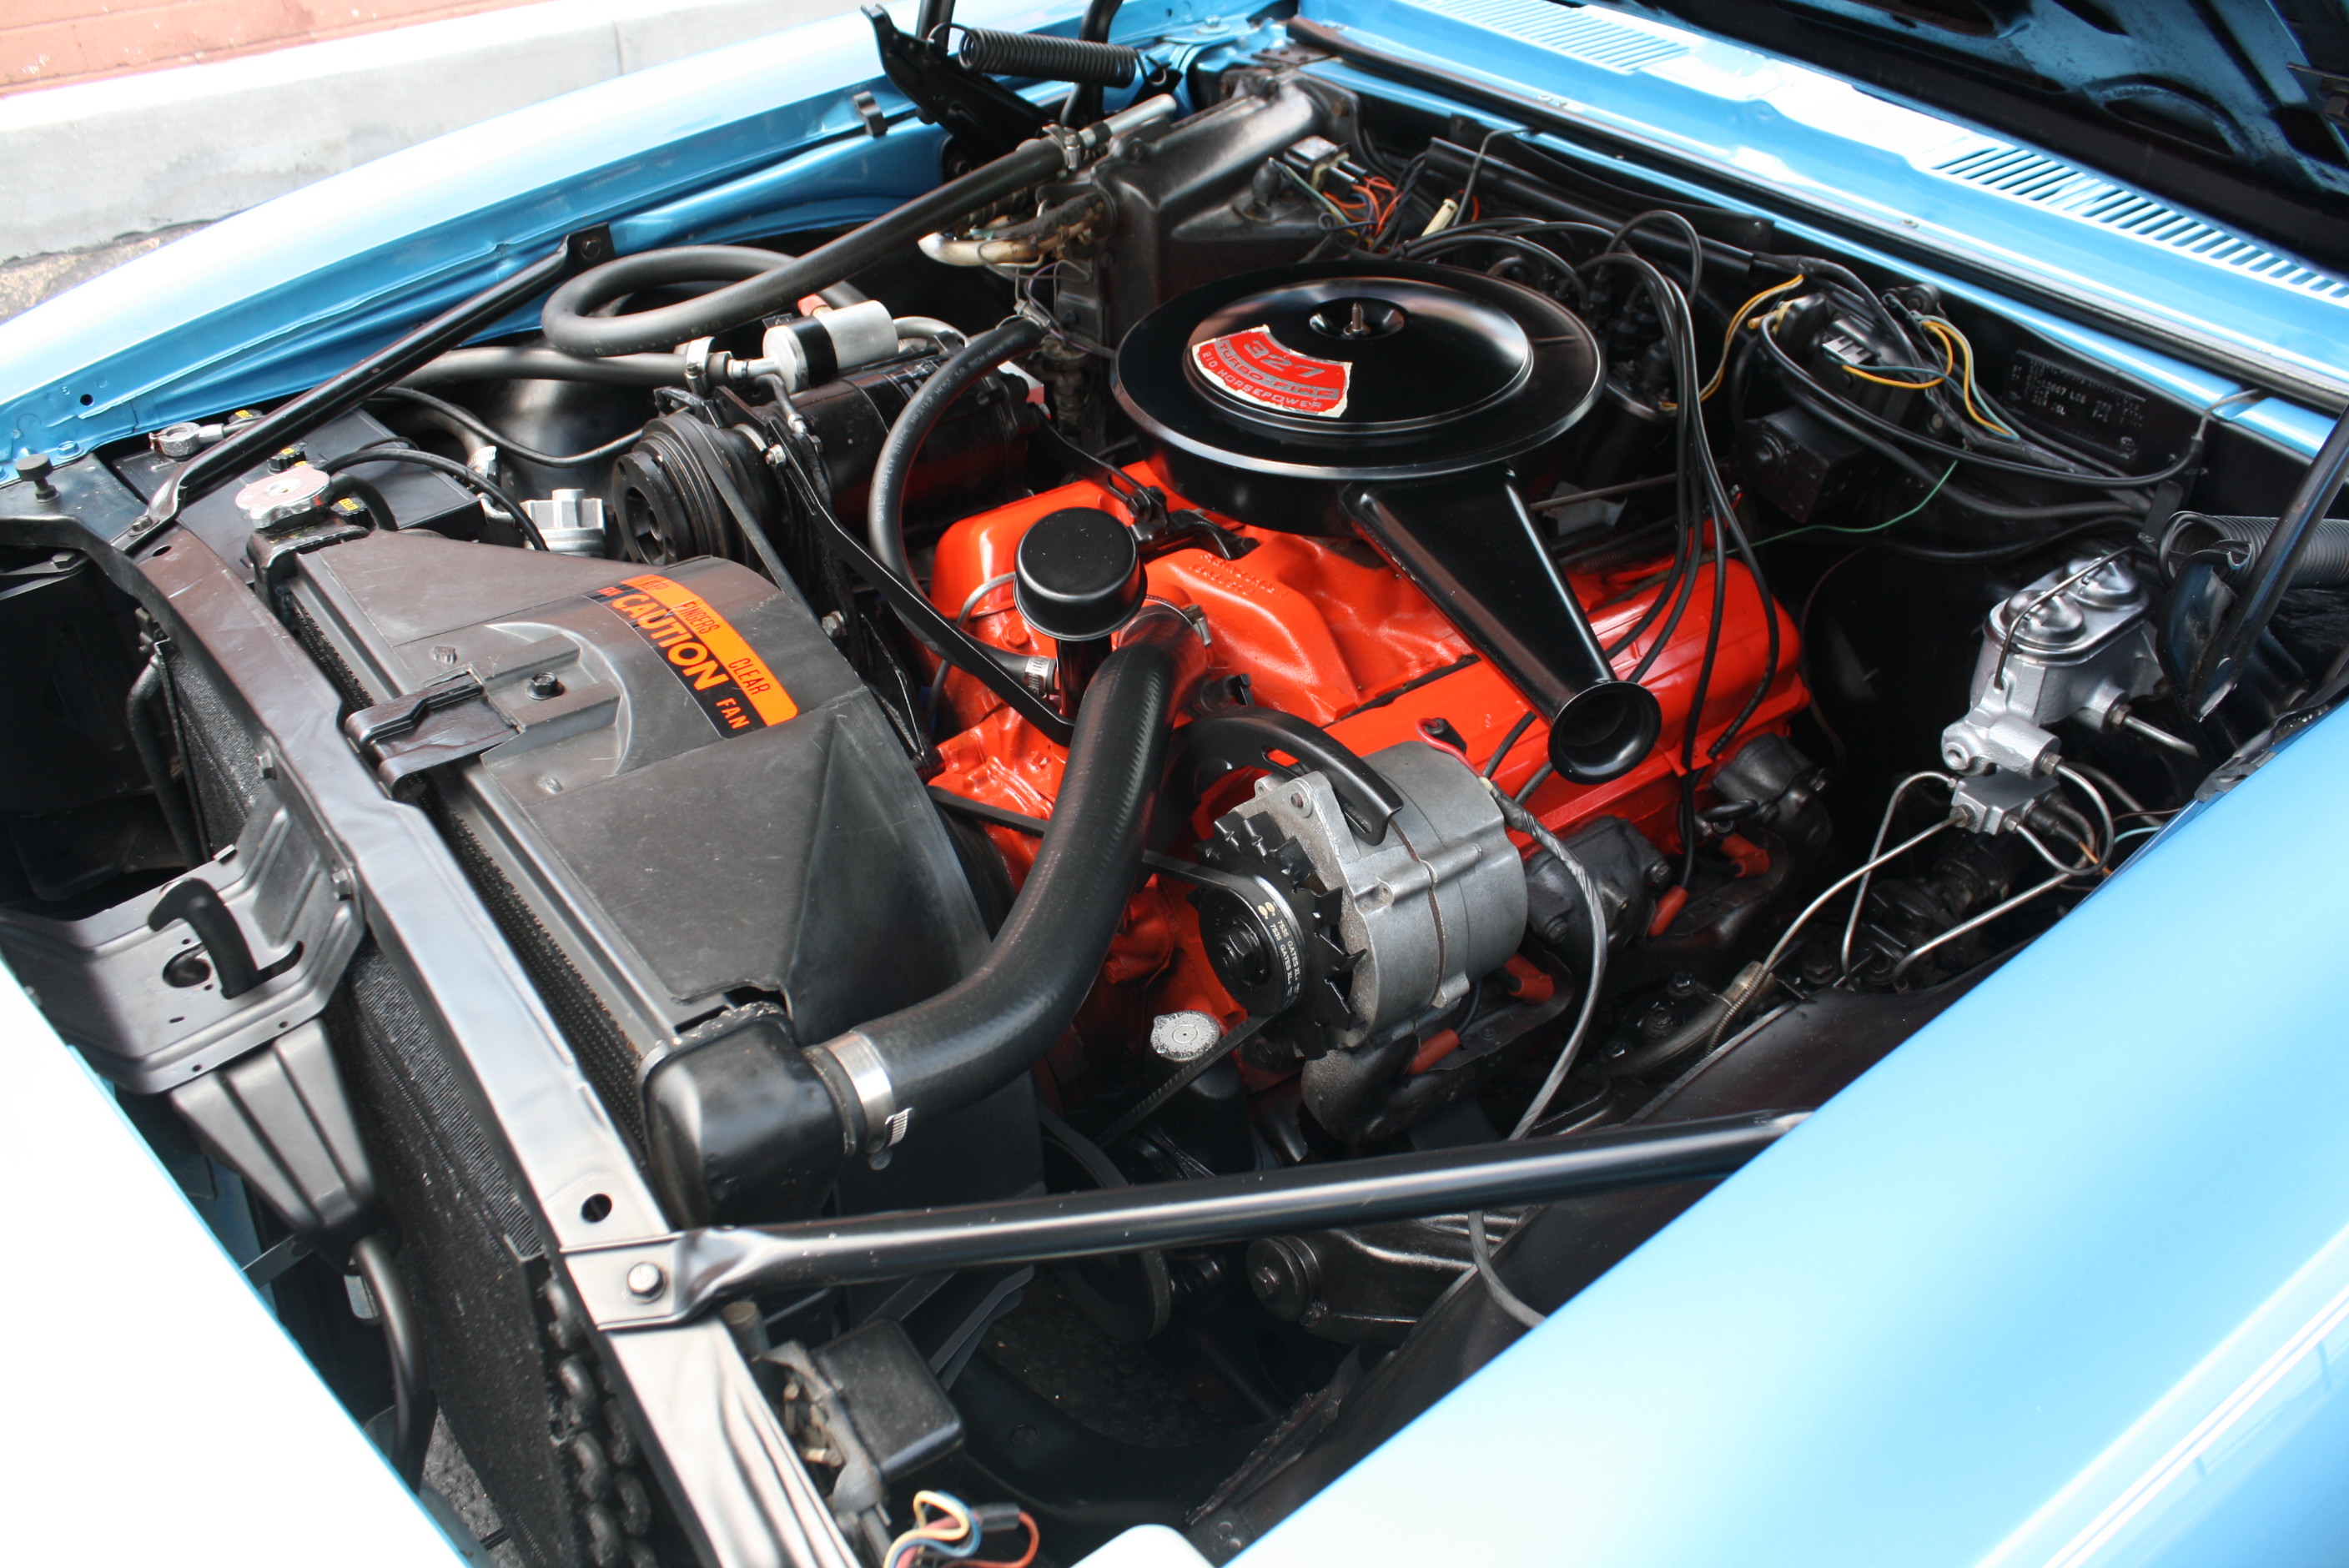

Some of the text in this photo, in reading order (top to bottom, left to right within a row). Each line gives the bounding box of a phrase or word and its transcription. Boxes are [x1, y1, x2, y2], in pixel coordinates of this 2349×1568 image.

[1202, 350, 1323, 409] 210 HORSEPOWER
[1218, 343, 1336, 398] TURBO-FIRE
[1243, 339, 1326, 378] 327
[677, 601, 721, 635] FINGERS
[611, 593, 730, 691] CAUTION
[716, 697, 750, 729] FAN
[727, 657, 772, 696] CLEAR
[1277, 919, 1290, 937] 7535
[1287, 940, 1299, 967] GATES
[1280, 943, 1292, 971] GATES
